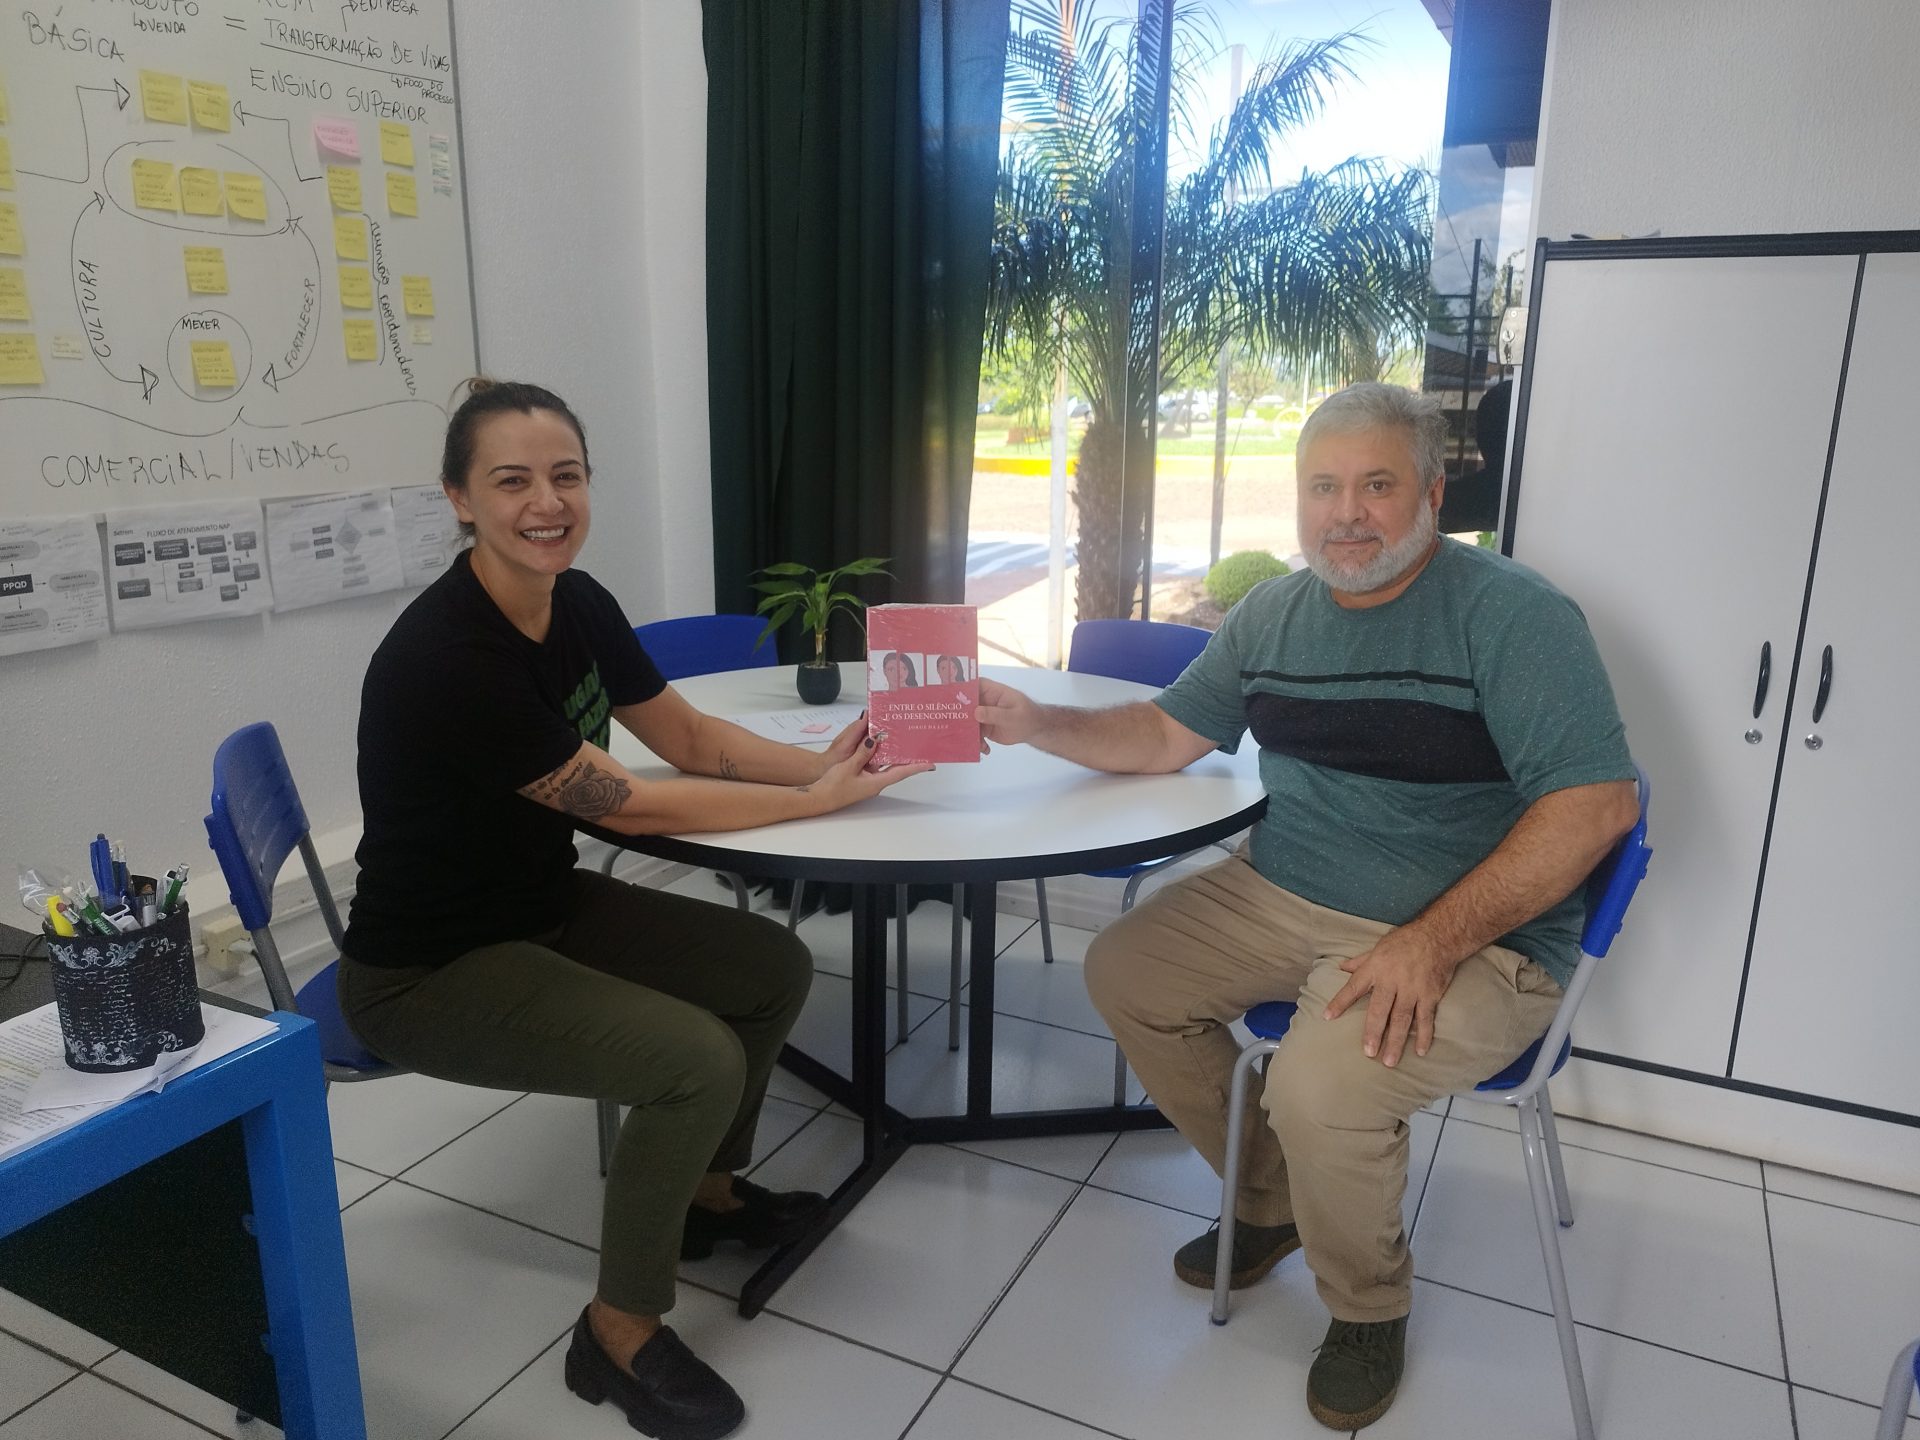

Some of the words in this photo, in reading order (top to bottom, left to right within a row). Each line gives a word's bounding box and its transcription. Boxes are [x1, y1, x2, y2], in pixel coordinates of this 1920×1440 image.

[264, 18, 383, 62] TRANSFORMAÇÃO
[391, 40, 413, 65] DE
[250, 67, 332, 100] ENSINO
[347, 87, 429, 125] SUPERIOR
[78, 259, 112, 358] CULTURA
[181, 318, 221, 331] MEXER
[284, 278, 316, 370] FORTALECER
[3, 580, 28, 591] PPQD
[889, 703, 914, 711] ENTRE
[917, 703, 924, 711] O
[904, 712, 969, 720] DESENCONTROS
